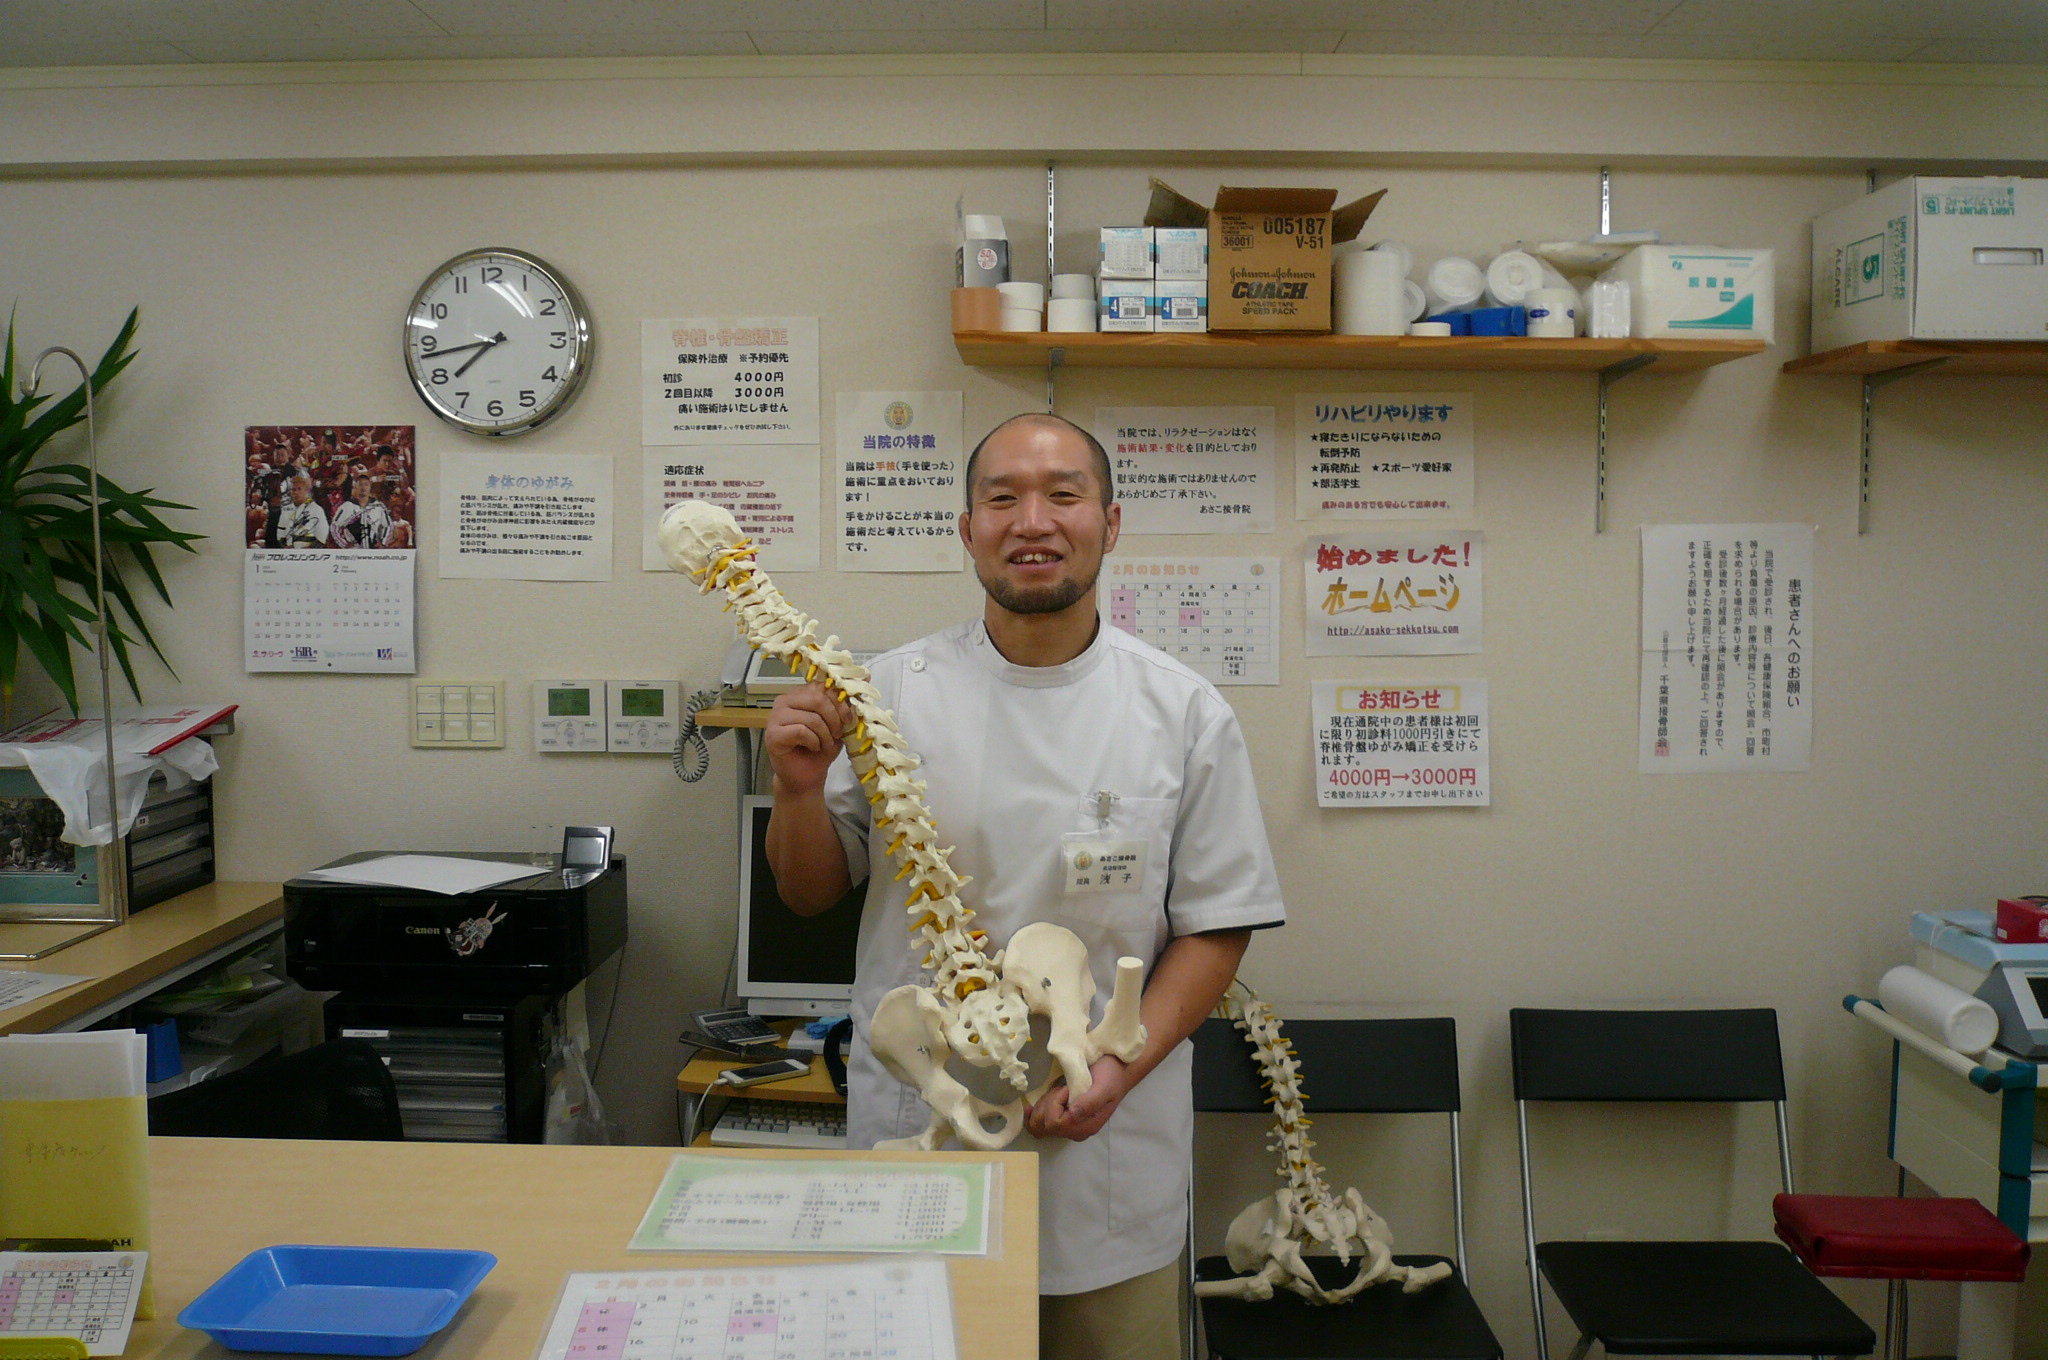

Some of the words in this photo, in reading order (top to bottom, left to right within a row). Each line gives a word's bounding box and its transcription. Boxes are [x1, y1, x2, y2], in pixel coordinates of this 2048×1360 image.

[1926, 200, 1937, 214] 5
[1263, 218, 1326, 235] 005187
[1223, 236, 1250, 246] 36001
[1296, 236, 1324, 248] V-51
[1861, 254, 1880, 284] 5
[481, 267, 503, 284] 12
[455, 276, 467, 294] 11
[522, 274, 527, 291] 1
[1232, 282, 1308, 299] COACH
[430, 303, 448, 320] 10
[539, 298, 556, 316] 2
[1110, 299, 1118, 312] 4
[1163, 300, 1170, 312] 4
[420, 335, 437, 352] 9
[549, 332, 566, 349] 3
[678, 354, 728, 364] 保険外治療
[431, 368, 449, 385] 8
[541, 366, 558, 382] 4
[663, 373, 683, 383] 初診
[519, 390, 536, 408] 5
[664, 388, 714, 399] 2回目以降
[455, 392, 470, 408] 7
[486, 400, 504, 417] 6
[678, 403, 788, 414] 痛い施術はいたしません
[1315, 404, 1453, 424] リハビリやります
[1116, 428, 1257, 438] 当院では、リラクゼーションはなく
[863, 434, 936, 450] 当院の特徴
[1116, 443, 1258, 454] 施術結果・変化を目的としており
[1319, 448, 1360, 458] 転倒予防
[1116, 459, 1138, 469] ます。
[664, 465, 705, 476] 適応症状
[485, 474, 574, 490] 身体のゆがみ
[845, 476, 954, 487] 施術に重点をおいており
[1116, 473, 1257, 484] 慰安的な施術ではありませんので
[1116, 489, 1217, 499] あらかじめご了承下さい。
[1199, 504, 1251, 514] あさこ接骨院
[846, 511, 954, 521] 手をかけることが本当の
[846, 526, 954, 537] 施術だと考えているから
[846, 542, 868, 552] です。
[255, 564, 260, 573] 1
[333, 564, 339, 573] 2
[1320, 573, 1460, 615] ホームページ
[1686, 541, 1696, 667] ますようお願い申し上げます。
[1327, 625, 1459, 636] http://asako-sekkotsu.com
[1786, 578, 1802, 708] 患者さんへのお願い
[1358, 689, 1441, 710] お知らせ
[1330, 715, 1479, 728] 現在通院中の患者様は初回
[1320, 728, 1481, 740] に限り初診料1000円引きにて
[1320, 741, 1478, 753] 脊椎骨盤ゆがみ矯正を受けら
[1321, 754, 1361, 766] れます。
[405, 926, 440, 935] Canon
